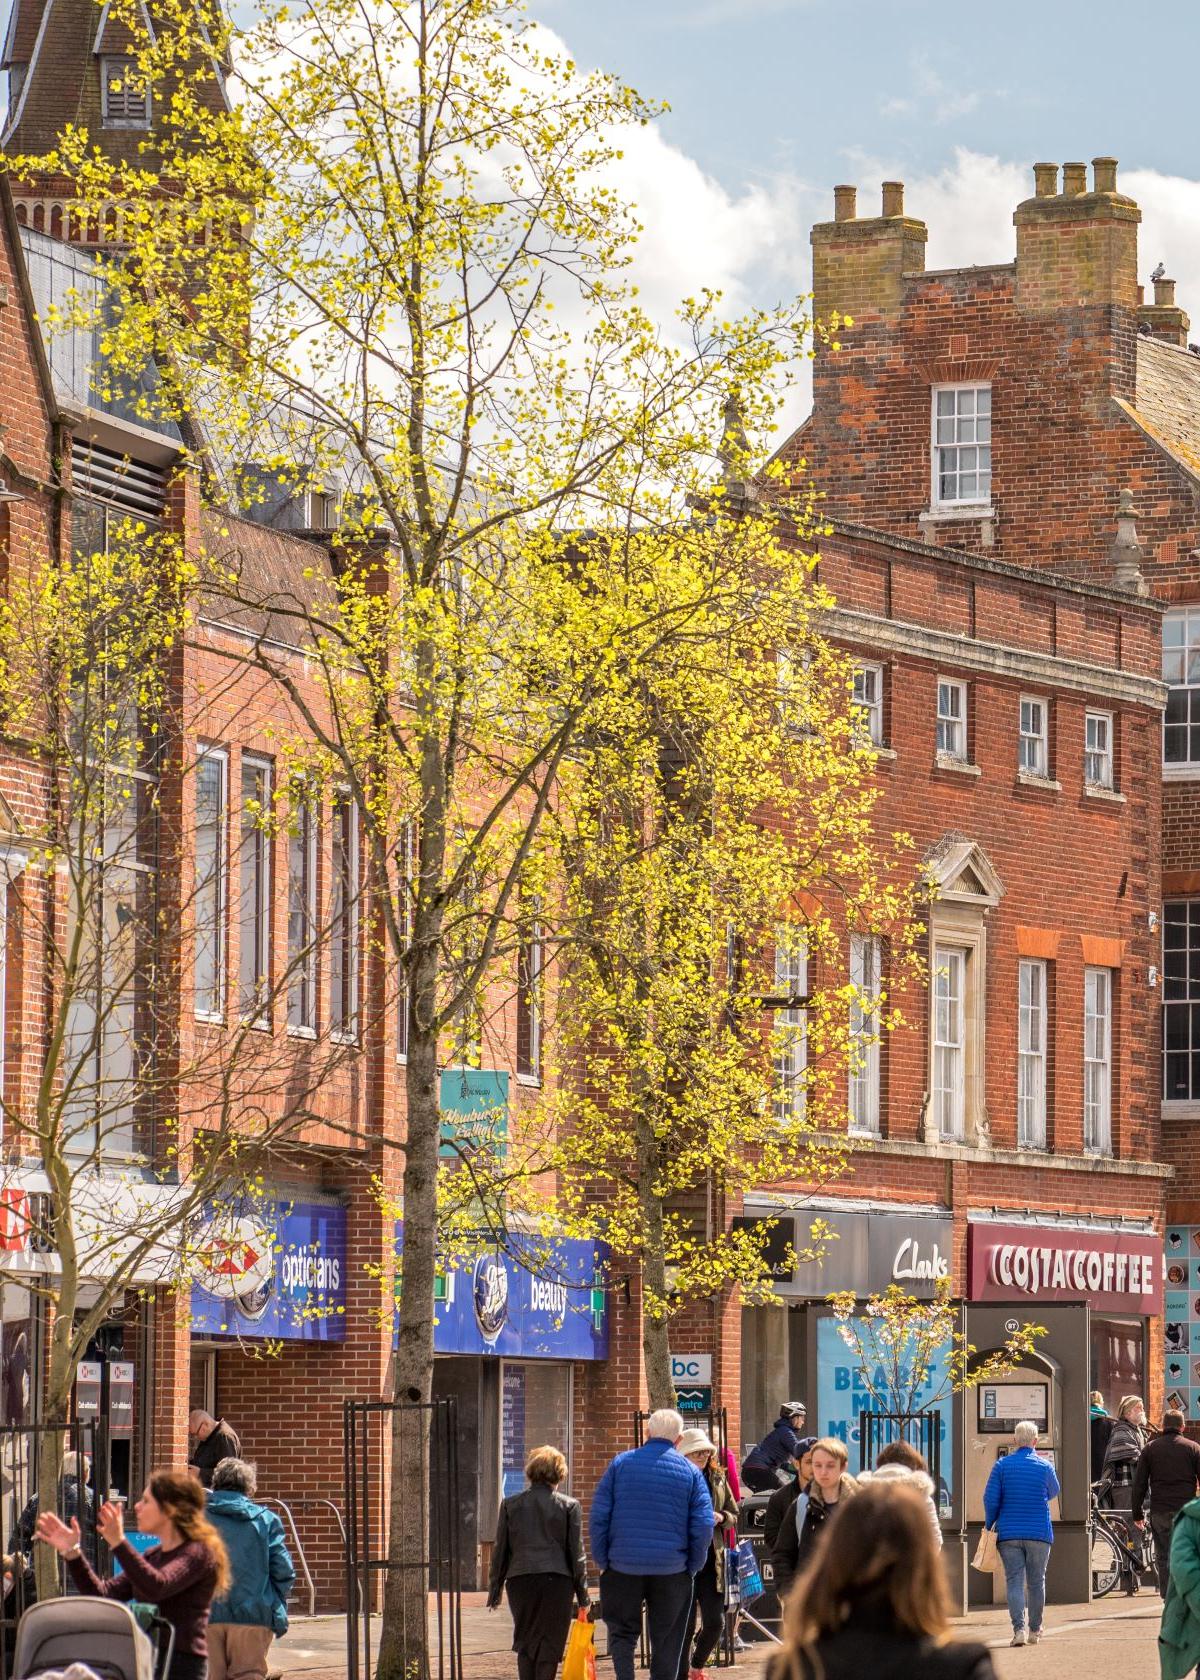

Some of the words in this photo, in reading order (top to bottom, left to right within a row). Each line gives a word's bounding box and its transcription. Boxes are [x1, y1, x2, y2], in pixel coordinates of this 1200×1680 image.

[282, 1246, 339, 1295] opticians
[893, 1238, 947, 1279] Clarks
[992, 1245, 1066, 1294] COSTA
[1066, 1251, 1153, 1294] COFFEE
[531, 1274, 567, 1322] beauty
